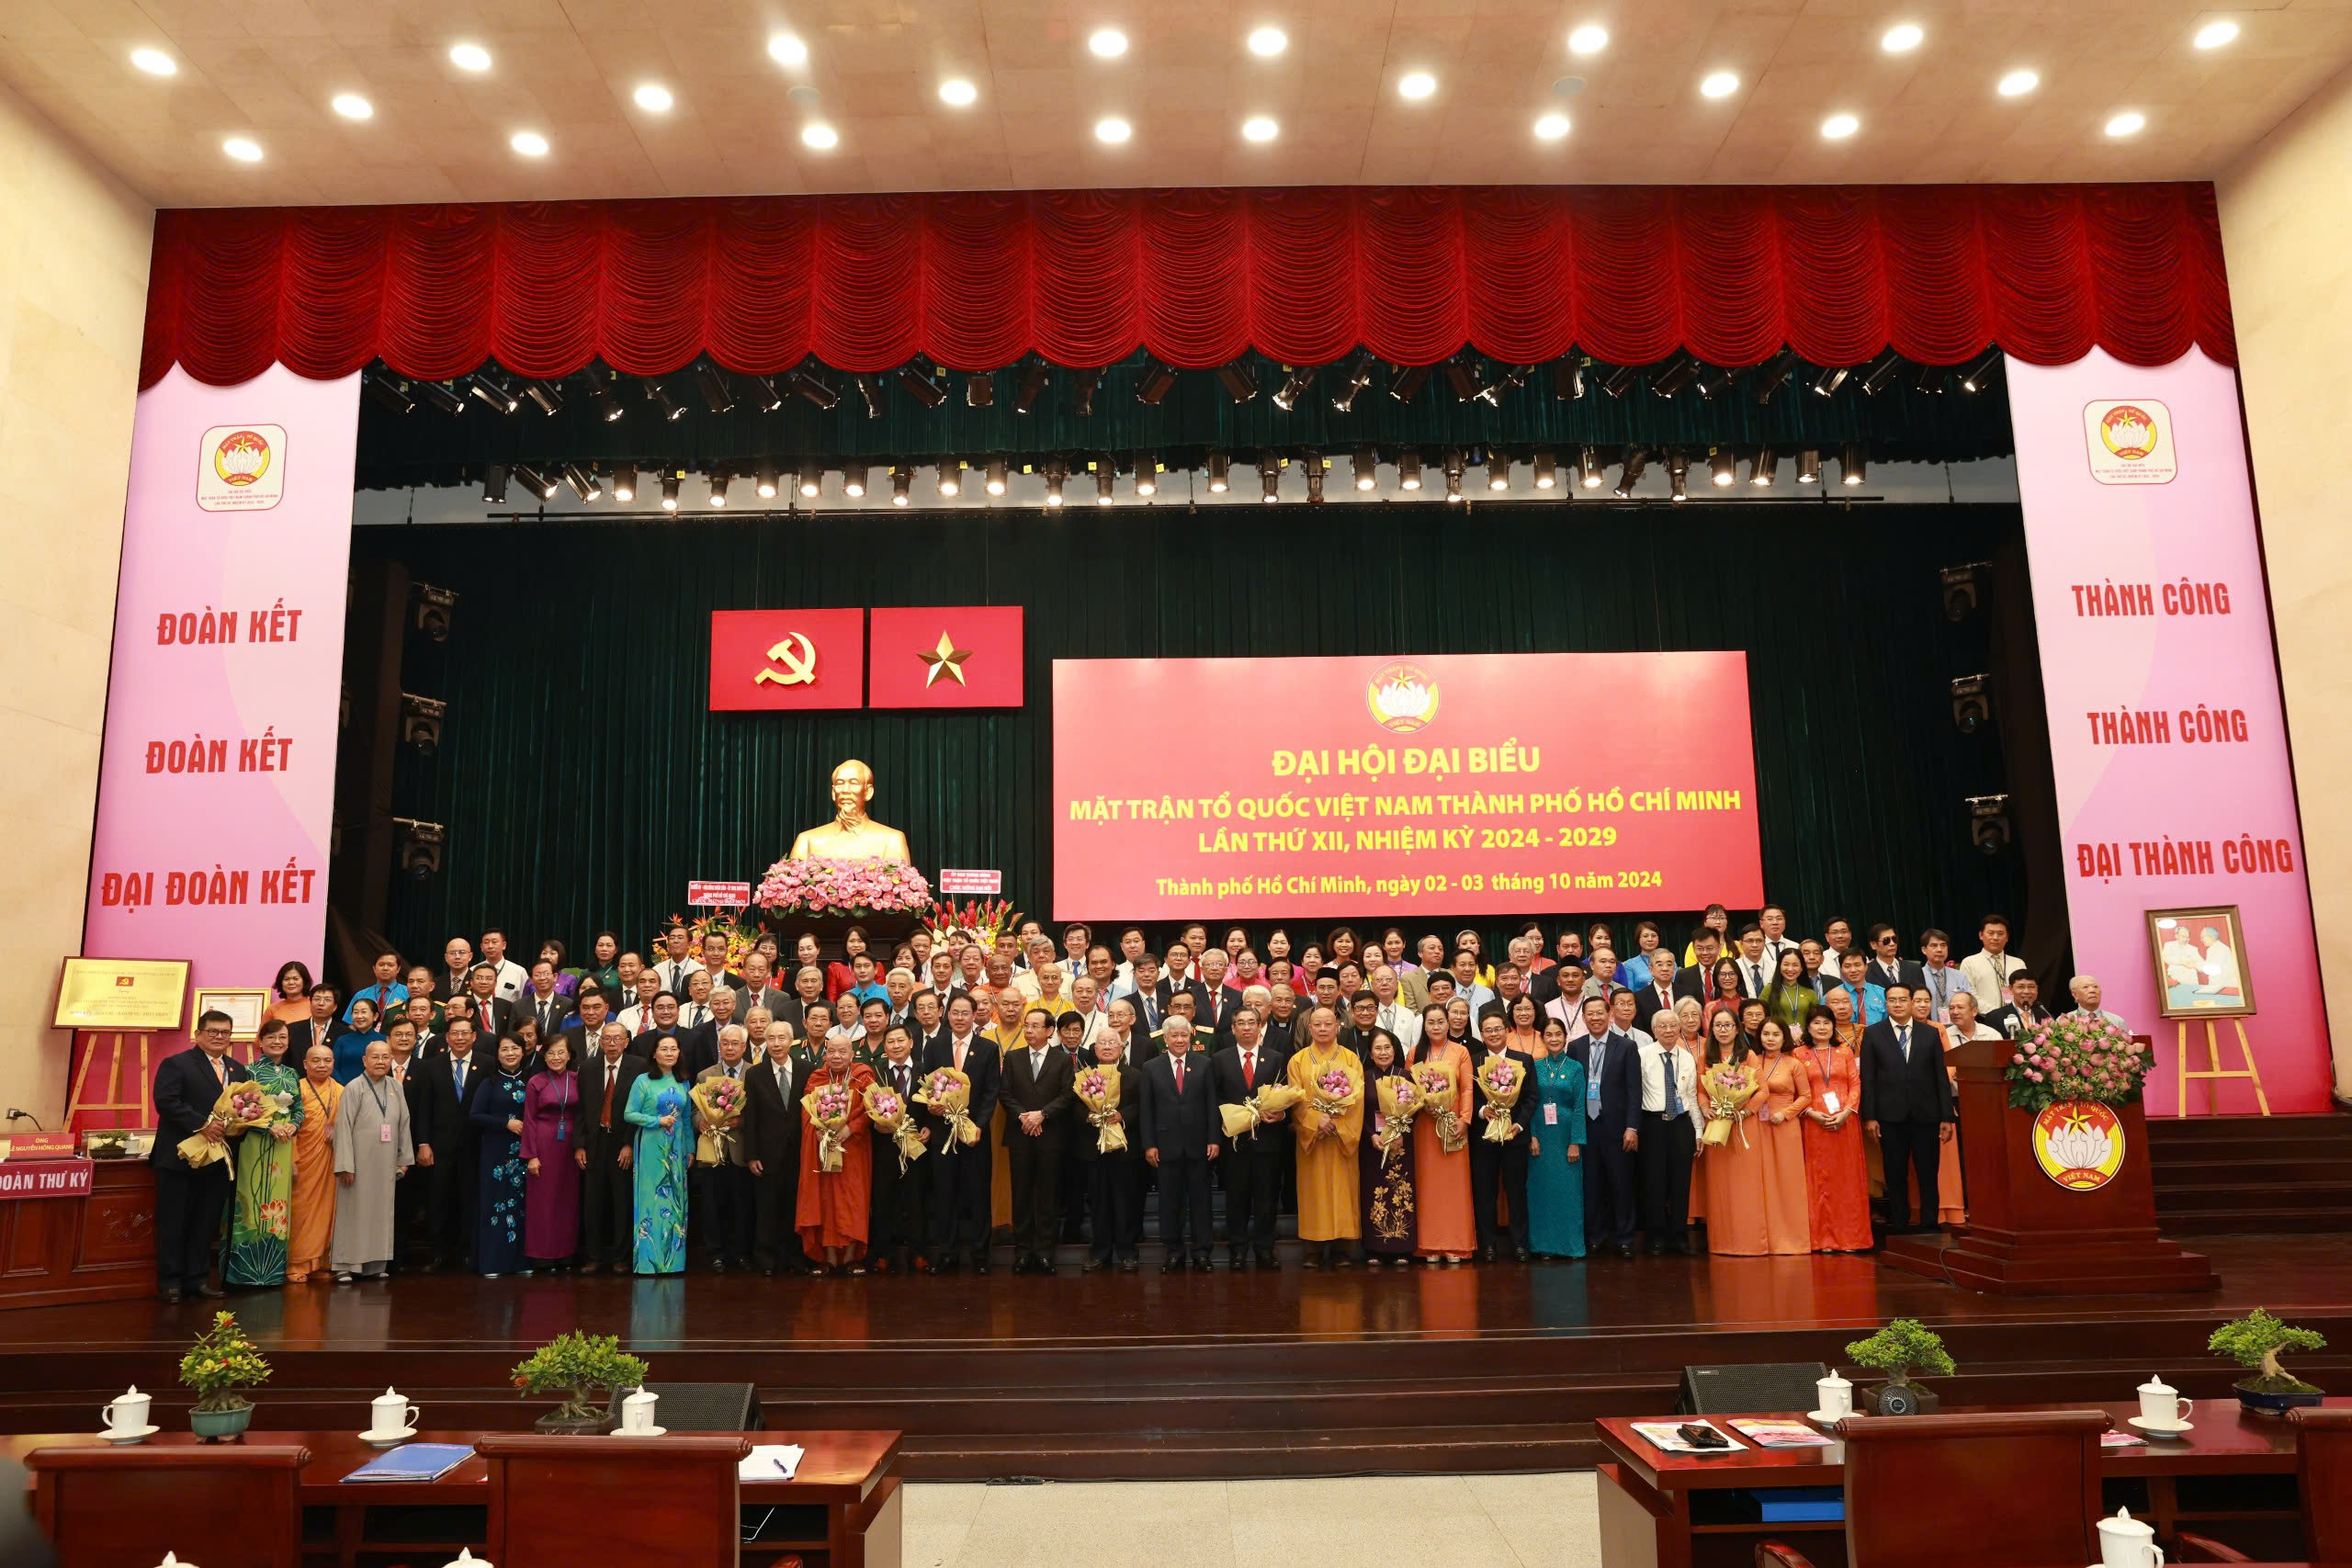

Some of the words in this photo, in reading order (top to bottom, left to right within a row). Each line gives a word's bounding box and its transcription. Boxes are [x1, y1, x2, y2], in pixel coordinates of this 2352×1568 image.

[2071, 579, 2154, 616] THÀNH
[2163, 577, 2231, 615] CÔNG
[157, 606, 237, 645] ĐOÀN
[249, 598, 301, 642] KẾT
[2087, 705, 2170, 744] THÀNH
[2179, 704, 2249, 743] CÔNG
[145, 733, 228, 773] ĐOÀN
[239, 726, 292, 772] KẾT
[1272, 750, 1330, 784] ĐẠI
[1338, 742, 1396, 783] HỘI
[1404, 748, 1461, 782] ĐẠI
[1468, 737, 1541, 772] BIỂU
[1070, 795, 1123, 827] MẶT
[1126, 794, 1194, 825] TRẬN
[1198, 791, 1232, 818] TỔ
[1237, 792, 1311, 821] QUỐC
[1316, 794, 1370, 822] VIỆT
[1374, 794, 1433, 816] NAM
[1436, 790, 1525, 816] THÀNH
[1528, 786, 1582, 813] PHỐ
[1587, 786, 1625, 813] HỒ
[1629, 786, 1671, 812] CHÍ
[1676, 790, 1742, 811] MINH
[1198, 827, 1249, 852] LẦN
[1252, 827, 1307, 852] THỨ
[1311, 830, 1351, 852] XII,
[1356, 825, 1438, 855] NHIỆM
[1442, 825, 1475, 850] KỲ
[1480, 828, 1540, 849] 2024
[1558, 826, 1617, 847] 2029
[2077, 843, 2122, 884] ĐẠI
[2129, 835, 2215, 875] THÀNH
[2222, 833, 2295, 874] CÔNG
[101, 872, 153, 914] ĐẠI
[165, 863, 249, 906] ĐOÀN
[260, 856, 316, 904] KẾT
[1155, 877, 1214, 896] Thành
[1217, 874, 1254, 899] phố
[1256, 874, 1283, 895] Hồ
[1286, 875, 1317, 897] Chí
[1320, 874, 1372, 897] Minh,
[1376, 874, 1420, 897] ngày
[1424, 874, 1448, 892] 02
[1460, 874, 1485, 892] 03
[1492, 872, 1545, 897] tháng
[1548, 872, 1572, 889] 10
[1574, 871, 1614, 889] năm
[1617, 871, 1664, 888] 2024
[0, 1170, 34, 1191] OÀN
[39, 1170, 68, 1190] THƯ
[70, 1168, 89, 1188] KÝ
[2083, 1172, 2102, 1183] NAM
